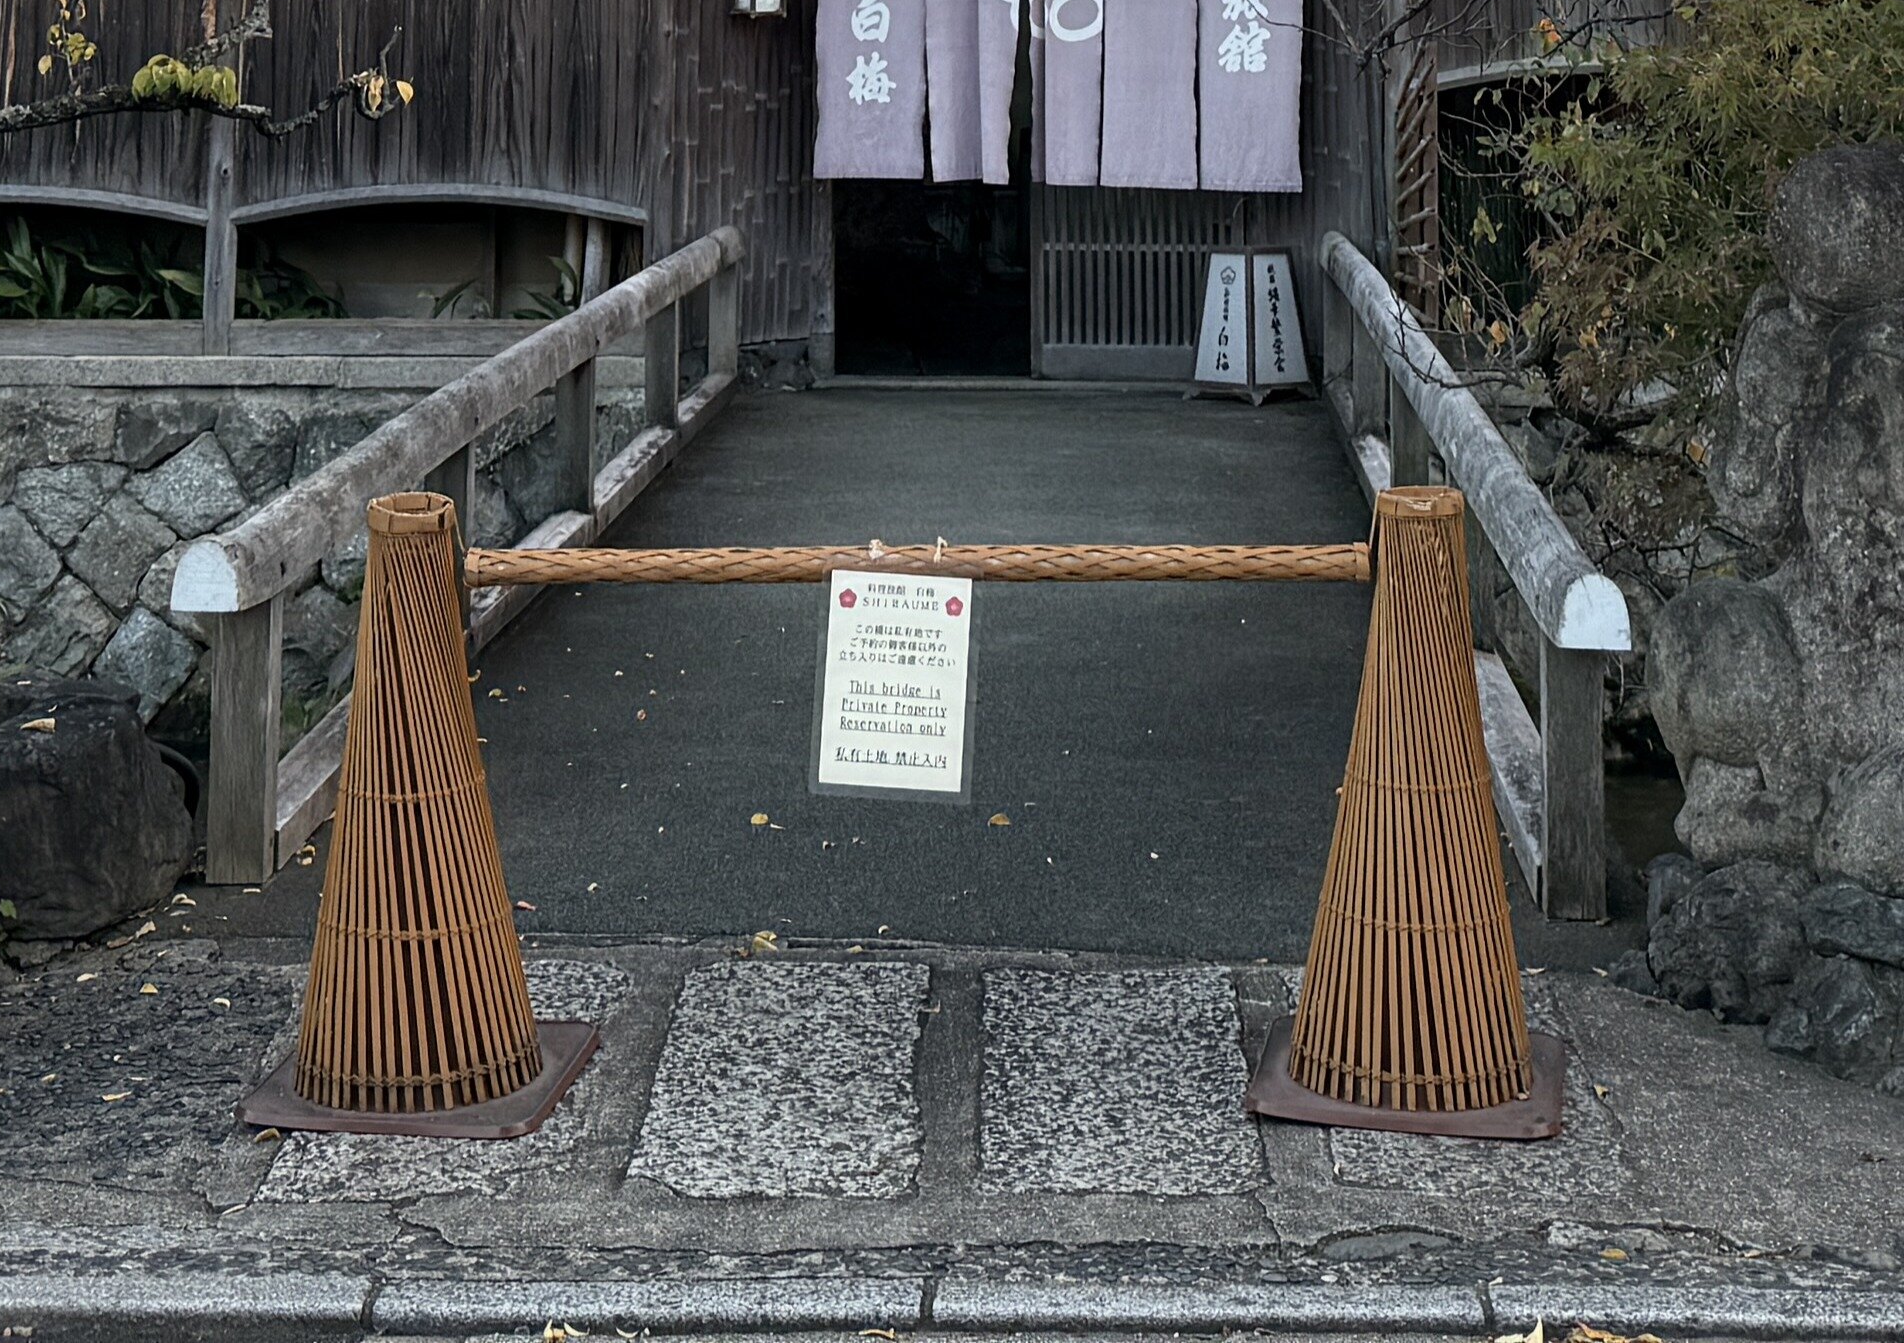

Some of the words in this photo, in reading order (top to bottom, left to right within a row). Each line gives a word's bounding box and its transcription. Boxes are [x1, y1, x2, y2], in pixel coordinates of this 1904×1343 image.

[863, 597, 939, 611] SHIRAUME
[850, 680, 875, 695] This
[882, 682, 921, 697] bridge
[930, 685, 941, 699] is
[841, 697, 887, 714] Private
[895, 701, 947, 718] Property
[840, 716, 913, 734] Reservation
[919, 722, 946, 737] only
